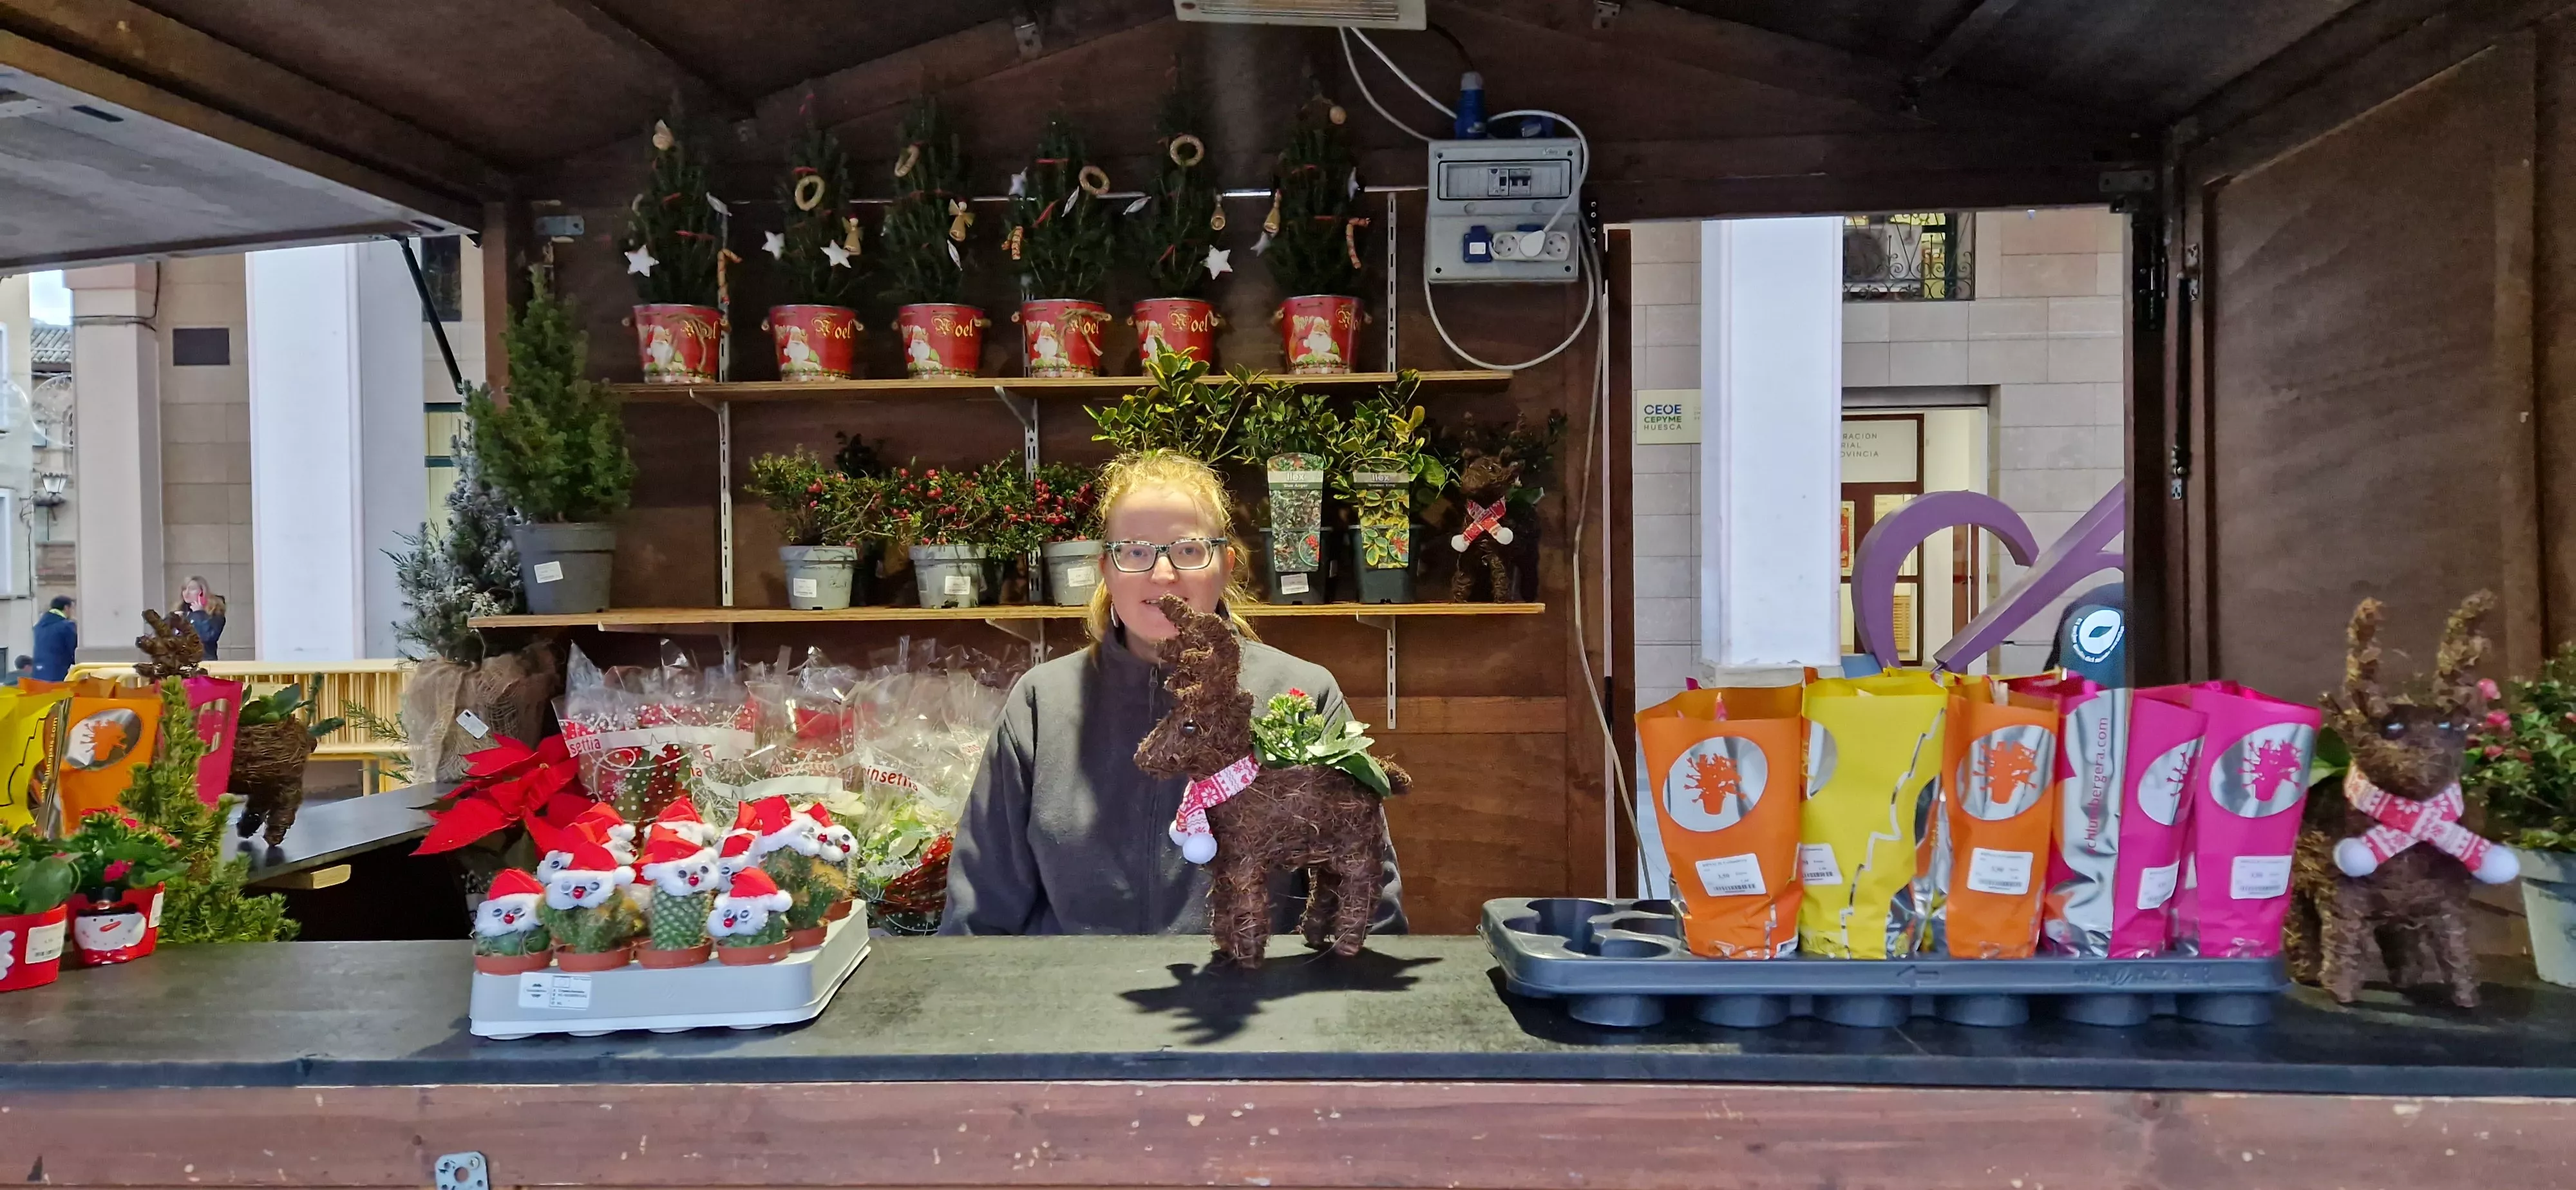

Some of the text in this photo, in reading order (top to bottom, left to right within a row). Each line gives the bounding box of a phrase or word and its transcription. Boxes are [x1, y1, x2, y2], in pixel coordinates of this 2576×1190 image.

[811, 316, 852, 339] Noel
[931, 315, 973, 337] Noel
[1168, 309, 1208, 332] Noel
[1643, 404, 1682, 415] CEOE
[1643, 415, 1682, 424] CEPYME
[1287, 471, 1305, 480] Ilex
